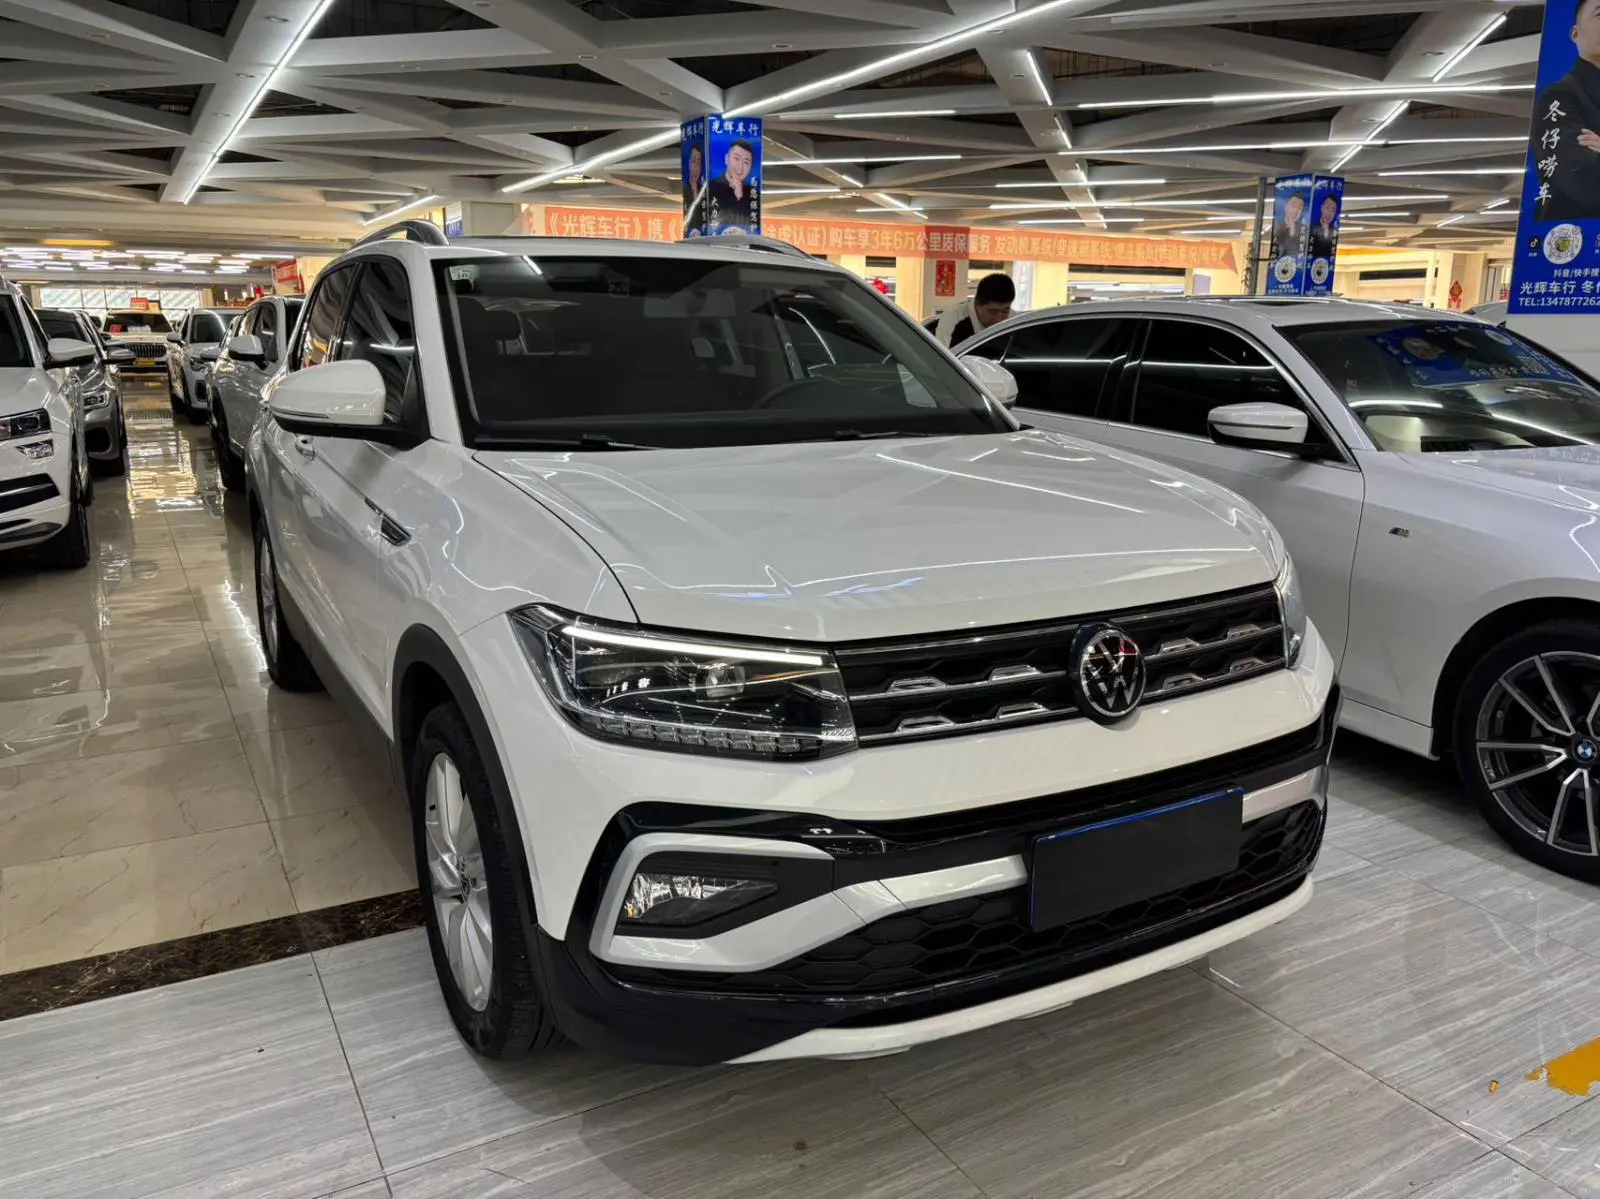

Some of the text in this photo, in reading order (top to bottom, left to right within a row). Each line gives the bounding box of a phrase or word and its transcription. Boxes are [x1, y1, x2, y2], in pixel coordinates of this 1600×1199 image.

[550, 212, 686, 239] 《光辉车行》携《
[1520, 281, 1577, 295] 光辉车行
